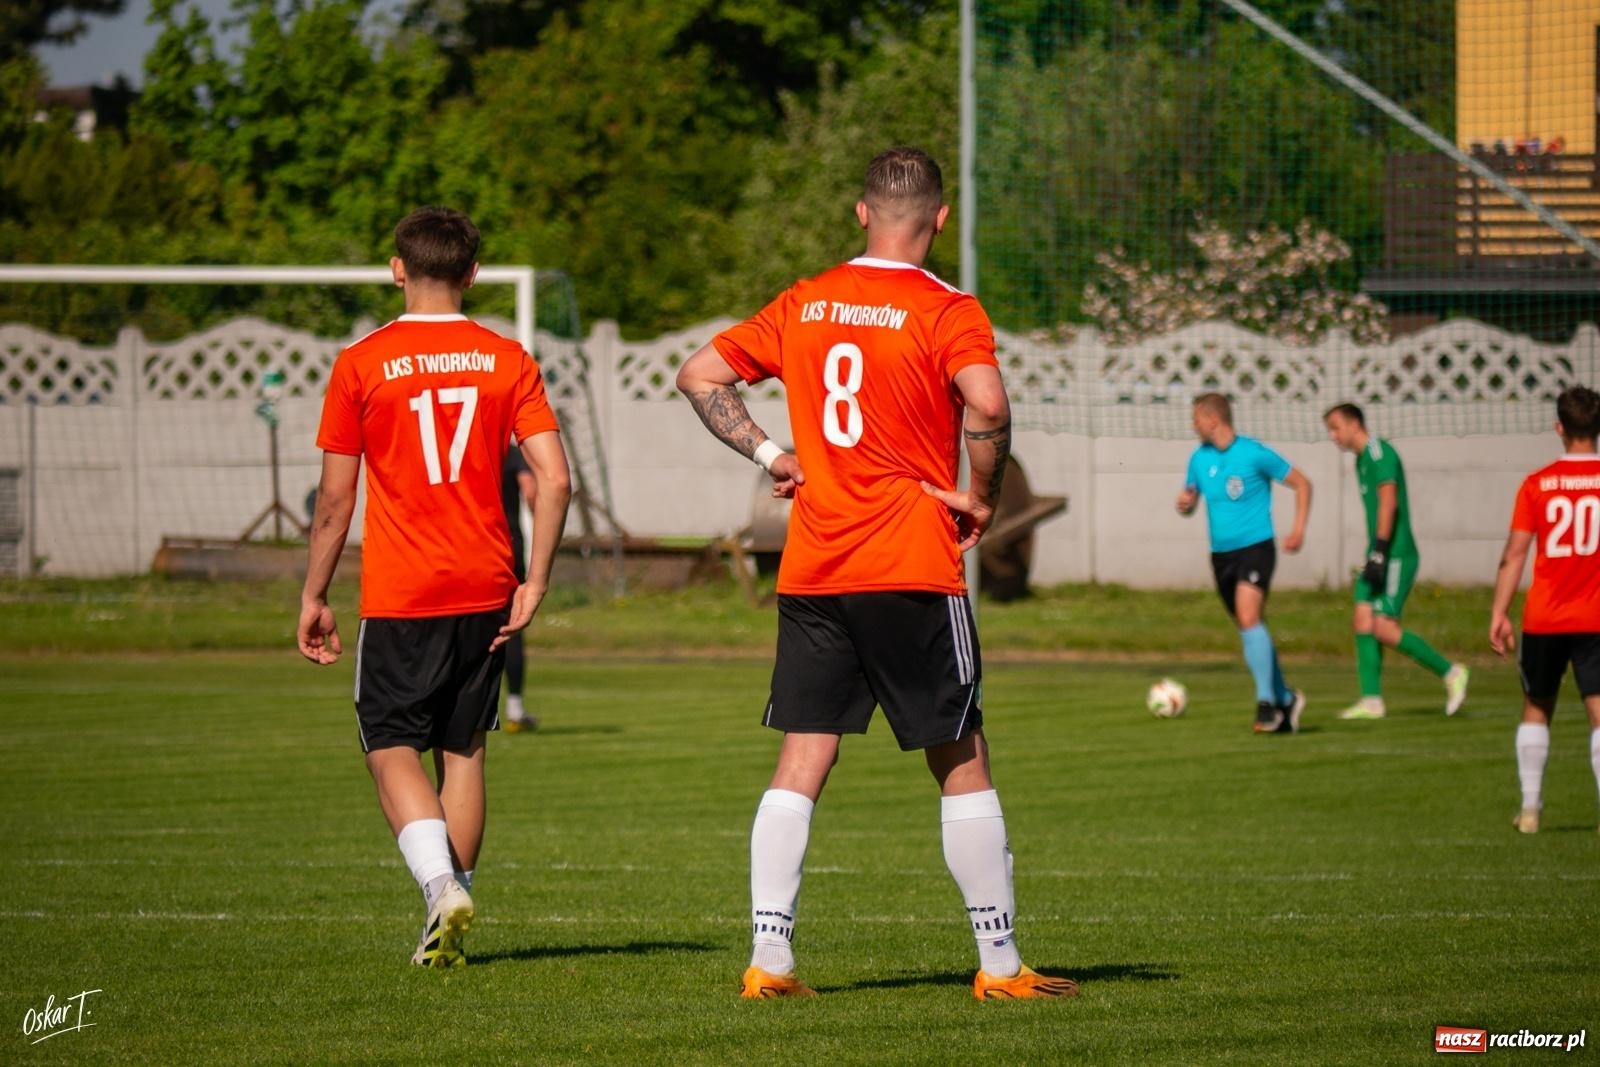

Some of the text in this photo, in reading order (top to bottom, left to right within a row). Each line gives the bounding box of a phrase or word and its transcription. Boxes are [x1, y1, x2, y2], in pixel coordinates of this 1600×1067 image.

[801, 300, 908, 330] LKS TWORKÓW
[383, 349, 496, 381] LKS TWORKÓW
[823, 342, 864, 448] 8
[408, 386, 478, 486] 17
[1545, 495, 1600, 558] 20
